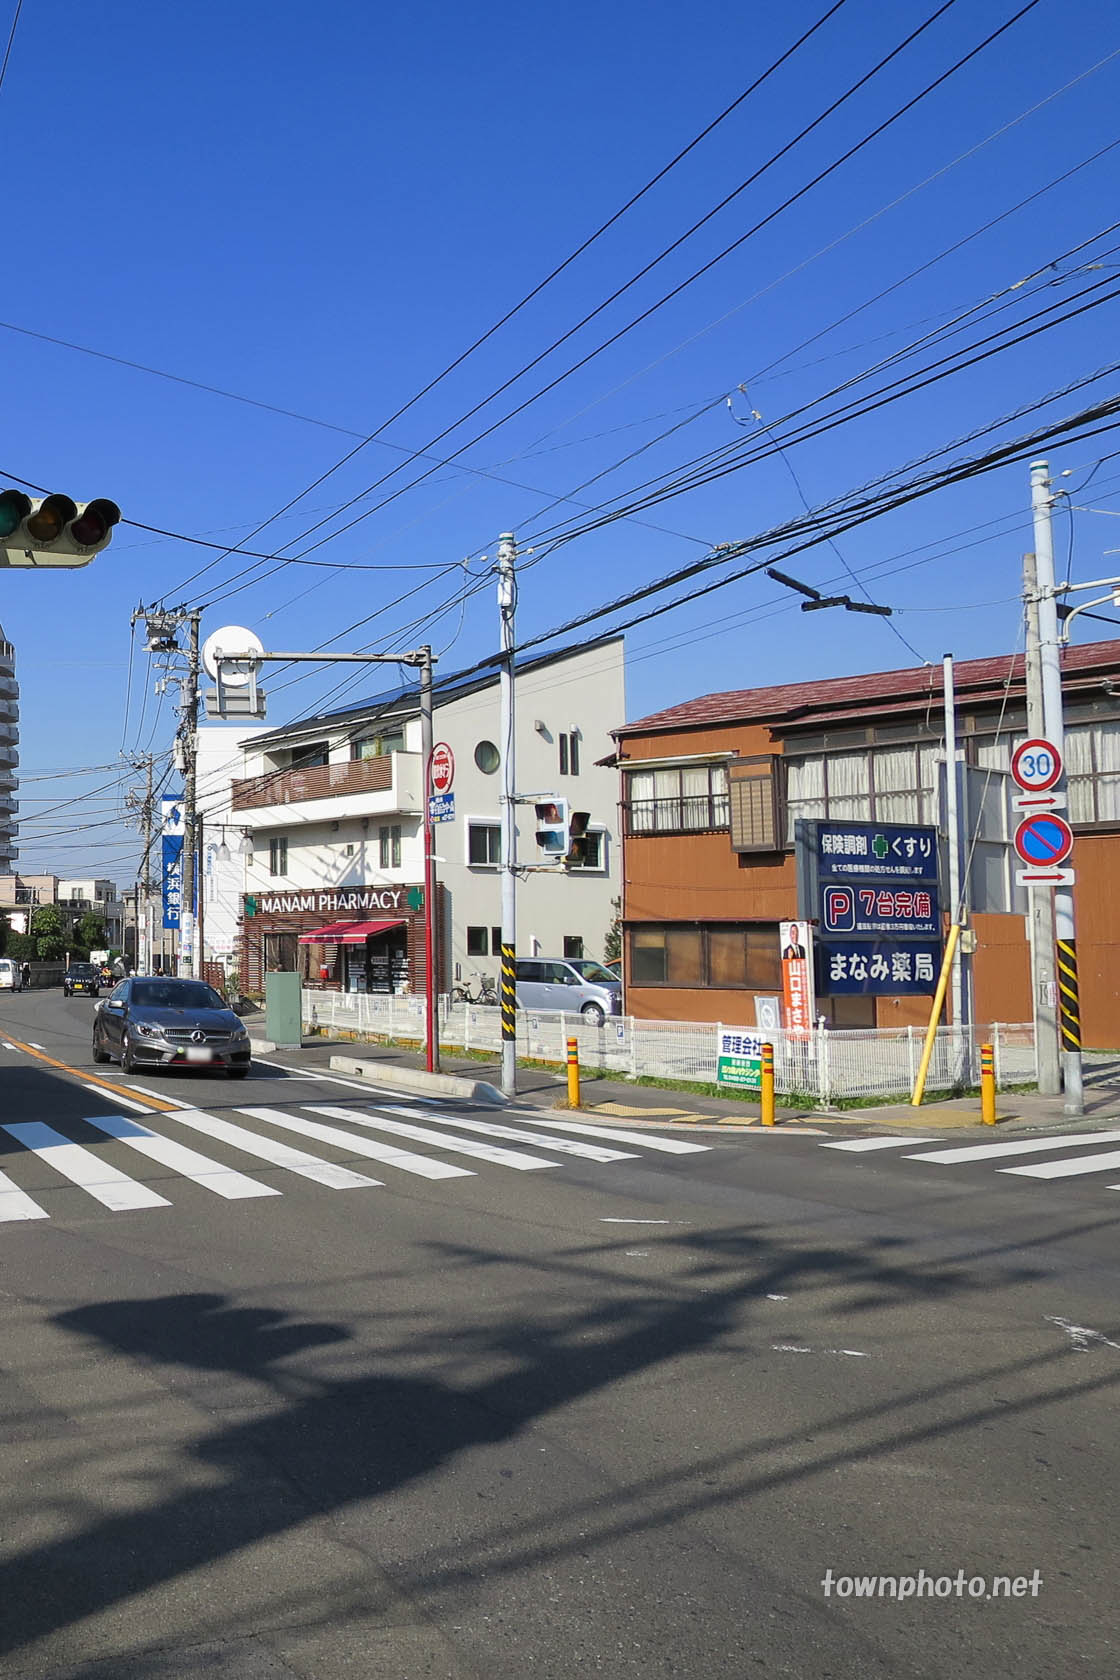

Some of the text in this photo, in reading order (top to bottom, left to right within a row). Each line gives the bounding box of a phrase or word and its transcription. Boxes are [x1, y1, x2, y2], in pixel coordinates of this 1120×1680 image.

[1023, 753, 1050, 777] 30
[822, 834, 931, 858] 保険調剤 くすり
[166, 861, 181, 922] 横浜銀行
[261, 891, 401, 914] MANAMI PHARMACY
[858, 889, 932, 919] 7台完備
[830, 893, 850, 926] P
[829, 952, 934, 983] まなみ薬局
[722, 1035, 761, 1056] 管理会社
